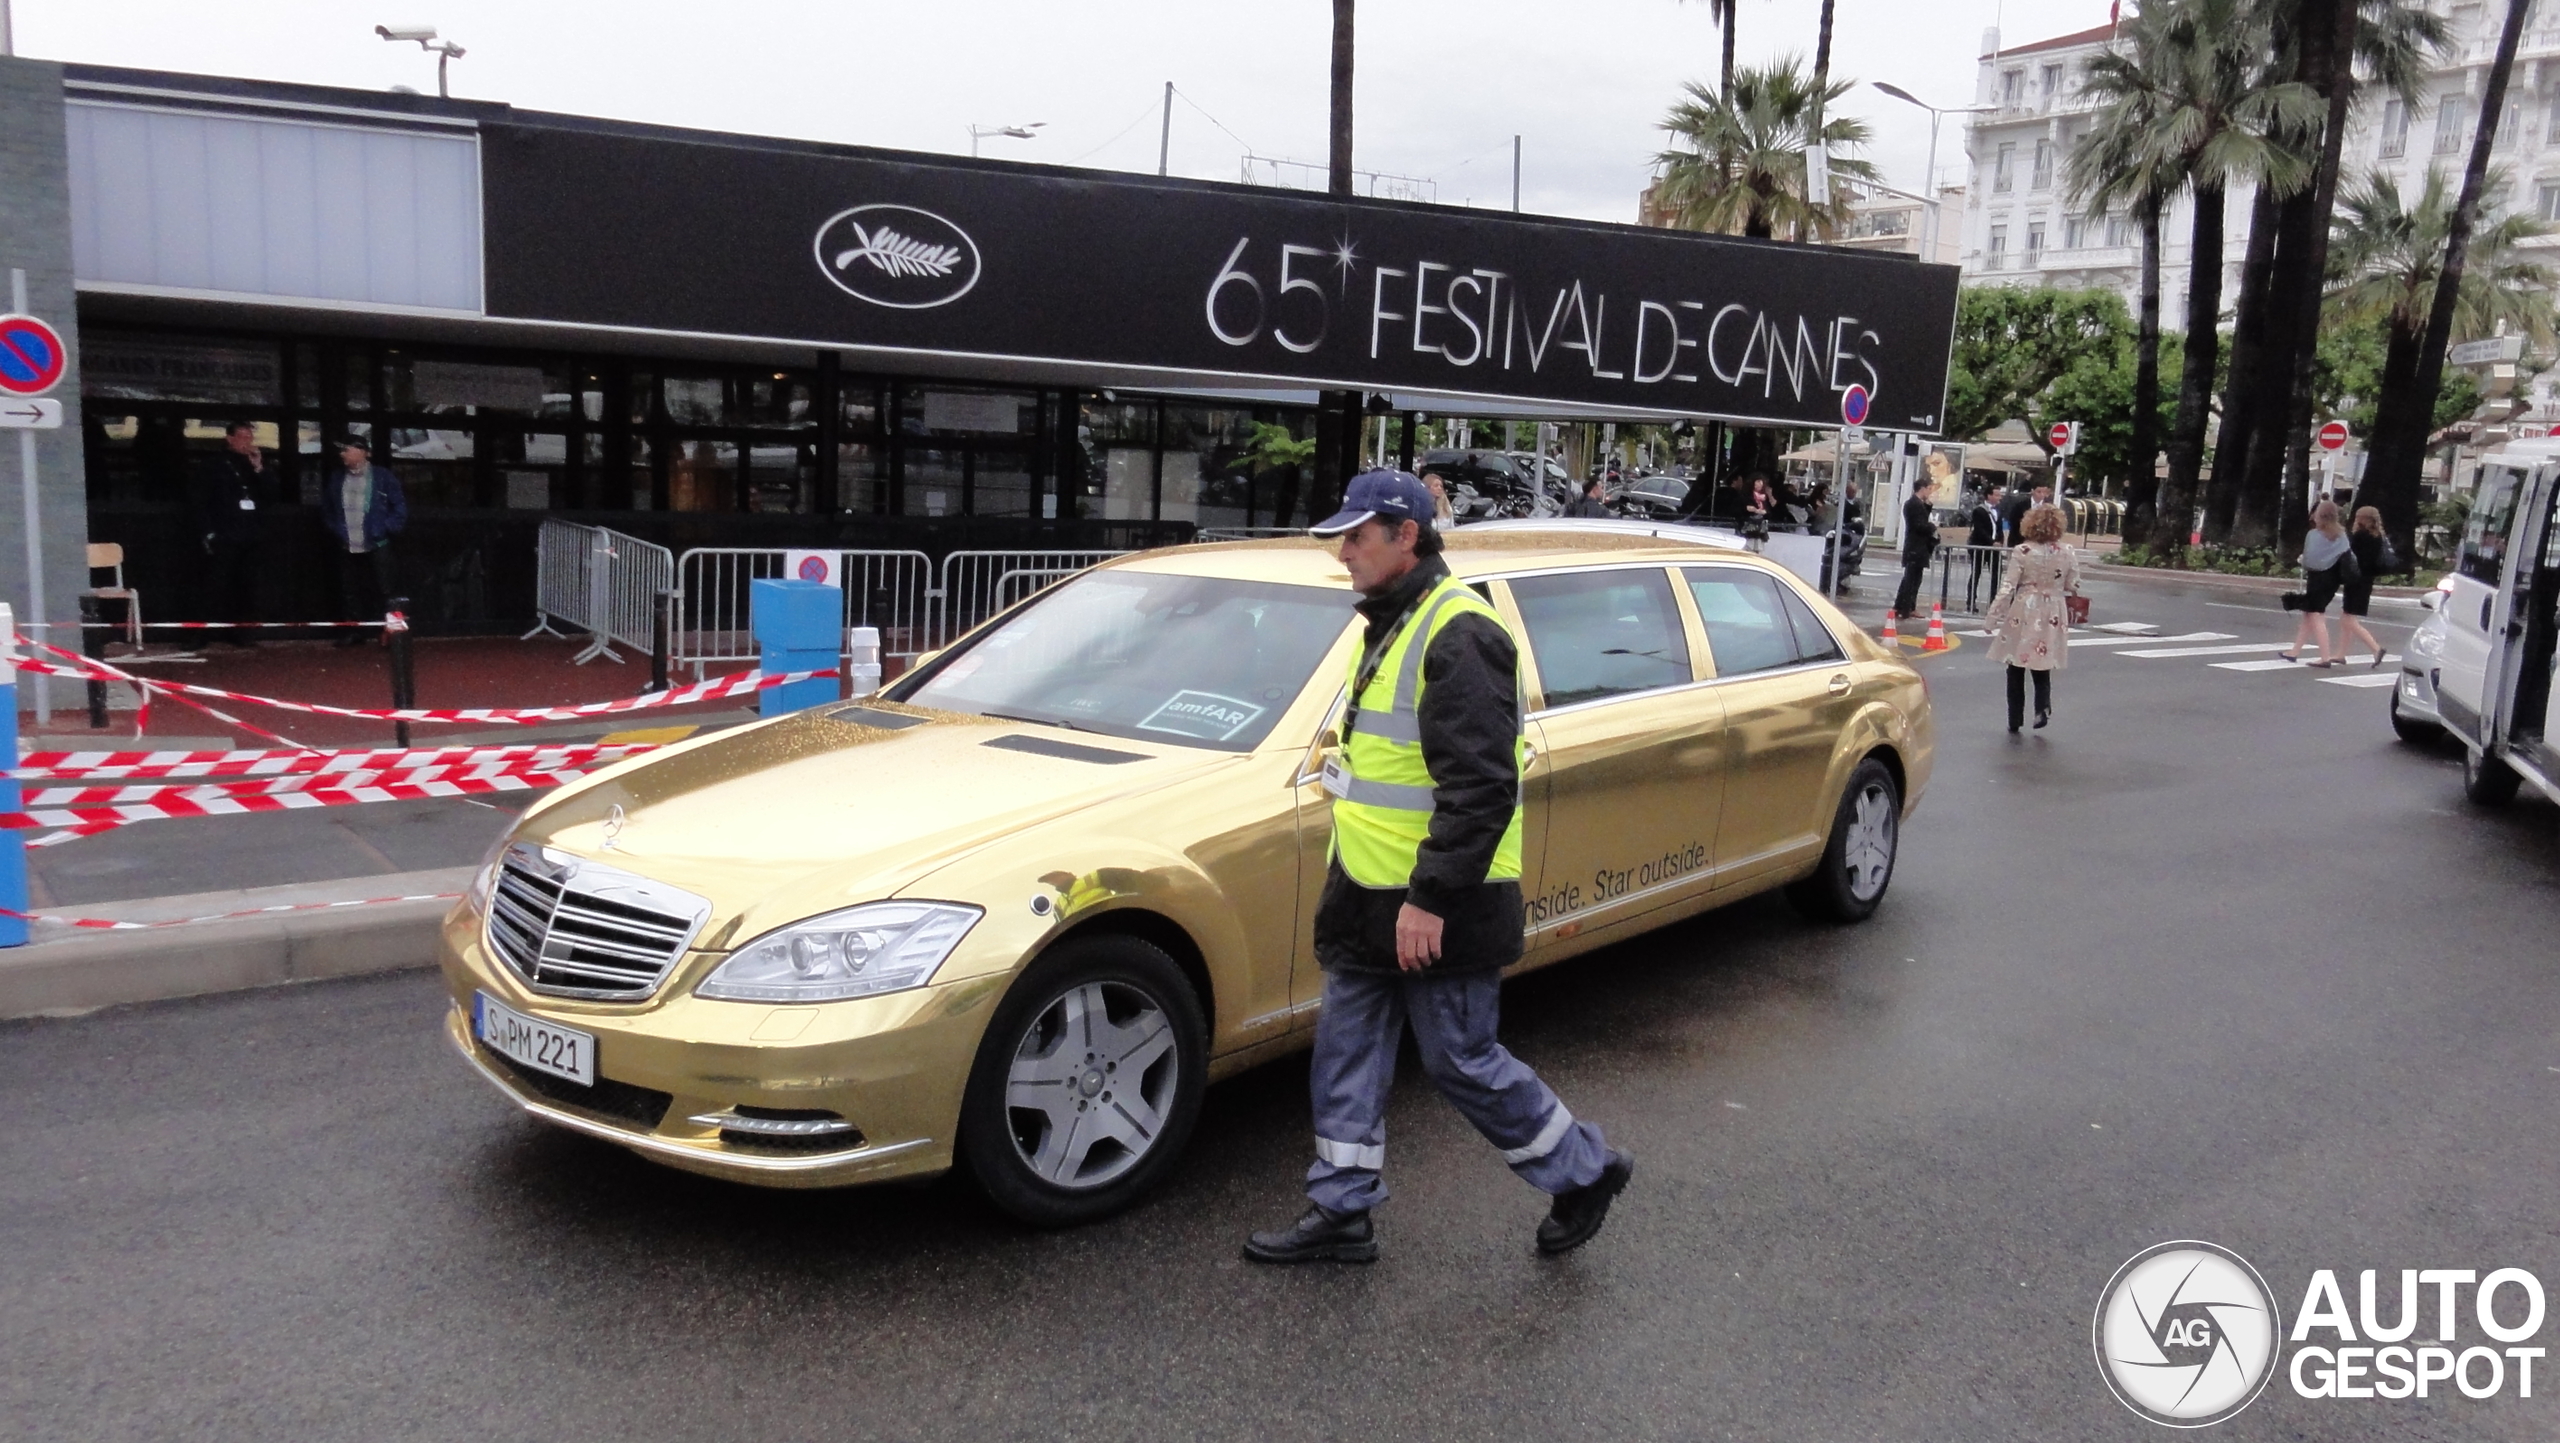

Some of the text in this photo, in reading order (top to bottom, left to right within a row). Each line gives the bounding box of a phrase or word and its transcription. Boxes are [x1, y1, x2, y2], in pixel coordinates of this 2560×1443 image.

[1370, 261, 1624, 380] FESTIVAL
[1634, 300, 1703, 383] DE
[1707, 304, 1880, 402] CANNES
[1168, 701, 1246, 725] amfAR
[1593, 866, 1635, 902] Star
[1639, 841, 1710, 887] outside.
[537, 1029, 580, 1075] 221
